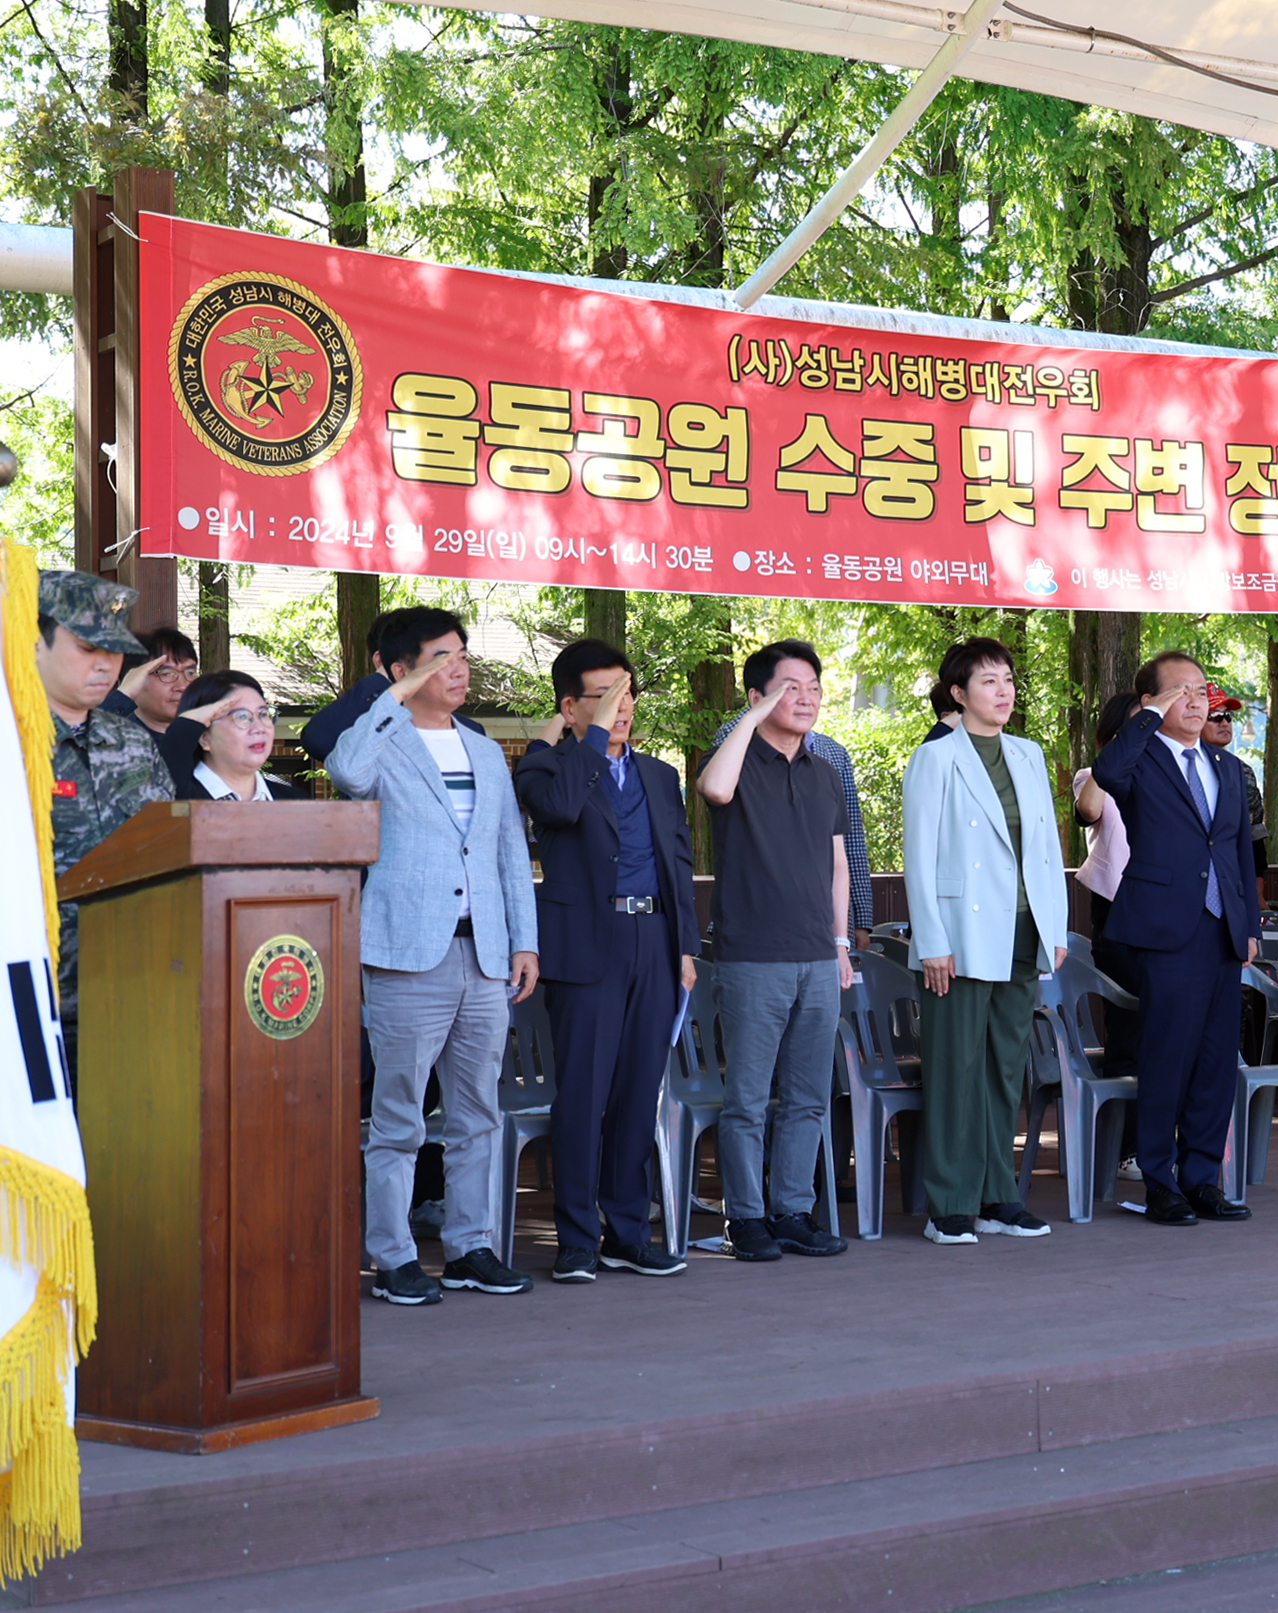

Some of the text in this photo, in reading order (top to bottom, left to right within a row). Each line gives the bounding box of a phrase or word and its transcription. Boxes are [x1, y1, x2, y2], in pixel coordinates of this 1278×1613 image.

[185, 285, 348, 368] 대한민국 성남시 해병대 전우회
[728, 335, 1100, 411] (사)성남시해병대전우회
[199, 408, 241, 450] MARINE
[242, 440, 303, 462] VETERANS
[303, 390, 348, 454] ASSOCIATION
[387, 371, 750, 509] 율동공원
[775, 413, 939, 521] 수중
[960, 425, 1035, 527] 및
[1059, 432, 1207, 534] 주변
[205, 507, 255, 539] 일시
[288, 516, 375, 548] 2024년
[433, 527, 527, 561] 29일(일)
[535, 536, 657, 569] 09시~14시
[665, 545, 714, 572] 30분
[753, 550, 797, 576] 장소
[821, 553, 904, 582] 율동공원
[909, 558, 989, 586] 야외무대
[1070, 568, 1087, 588] 이
[1092, 568, 1142, 590] 행사는
